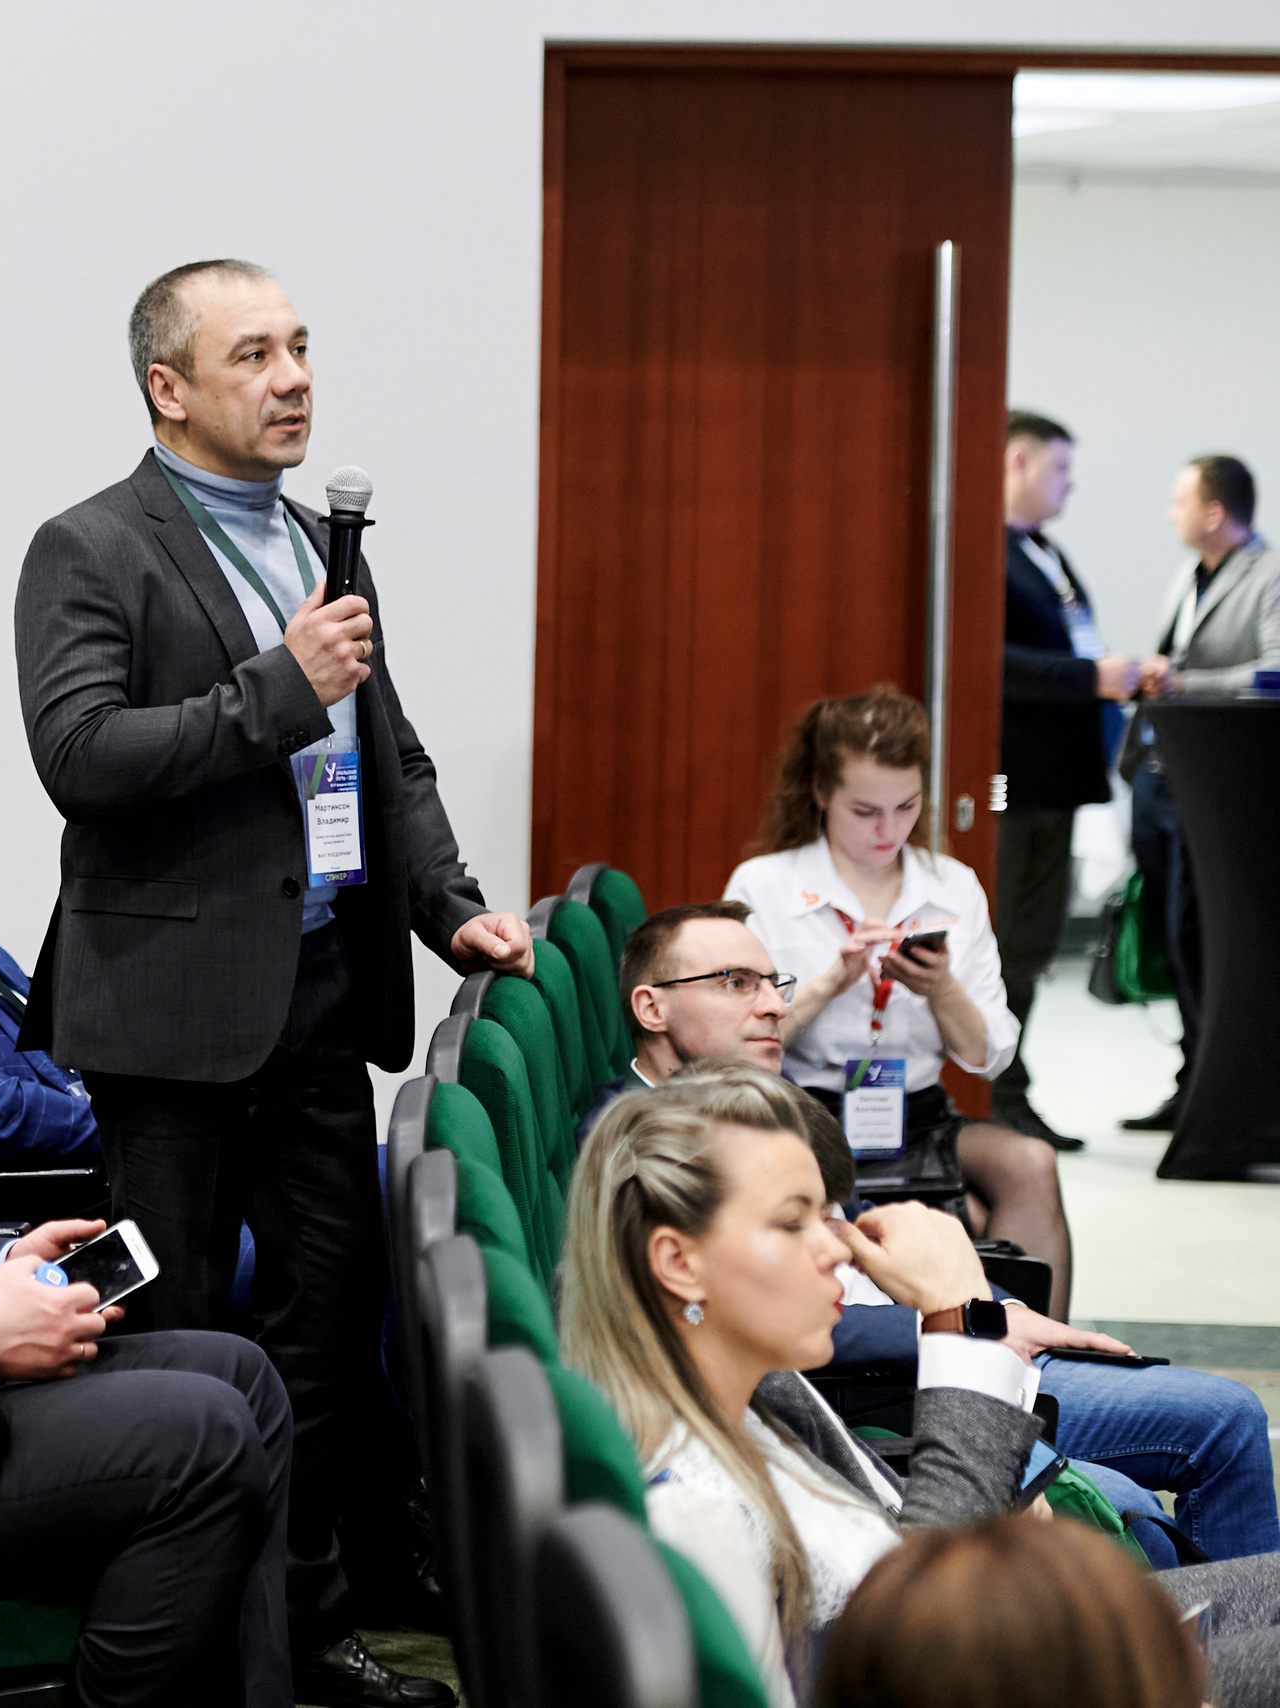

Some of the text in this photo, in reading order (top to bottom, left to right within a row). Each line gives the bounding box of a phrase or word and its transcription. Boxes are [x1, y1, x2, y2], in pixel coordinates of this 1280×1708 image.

[315, 804, 350, 812] Мартинсон
[317, 817, 350, 825] Владимир
[325, 873, 348, 882] СПИКЕР
